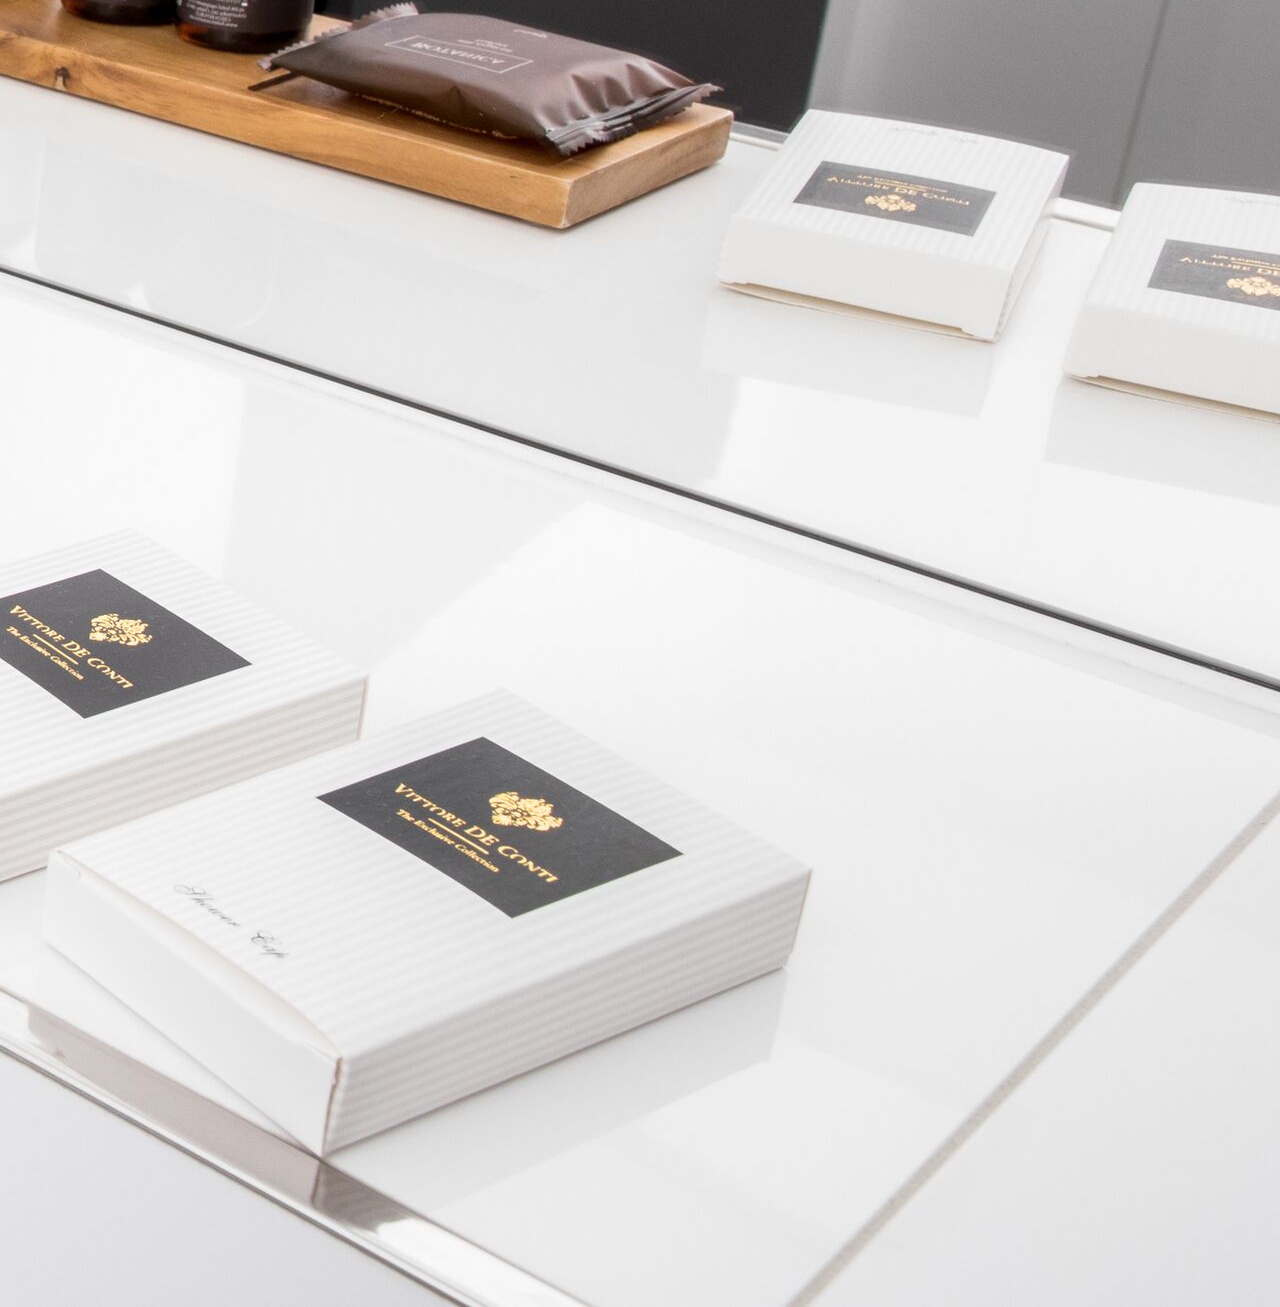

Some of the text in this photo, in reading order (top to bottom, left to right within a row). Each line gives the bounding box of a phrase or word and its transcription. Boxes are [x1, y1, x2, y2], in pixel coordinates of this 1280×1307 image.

[6, 626, 22, 638] The
[19, 634, 51, 657] Exclusive
[9, 604, 134, 689] VITTORE DE CONTI
[394, 782, 560, 884] VITTORE DE CONTI
[395, 808, 501, 874] The Exclusive Collection
